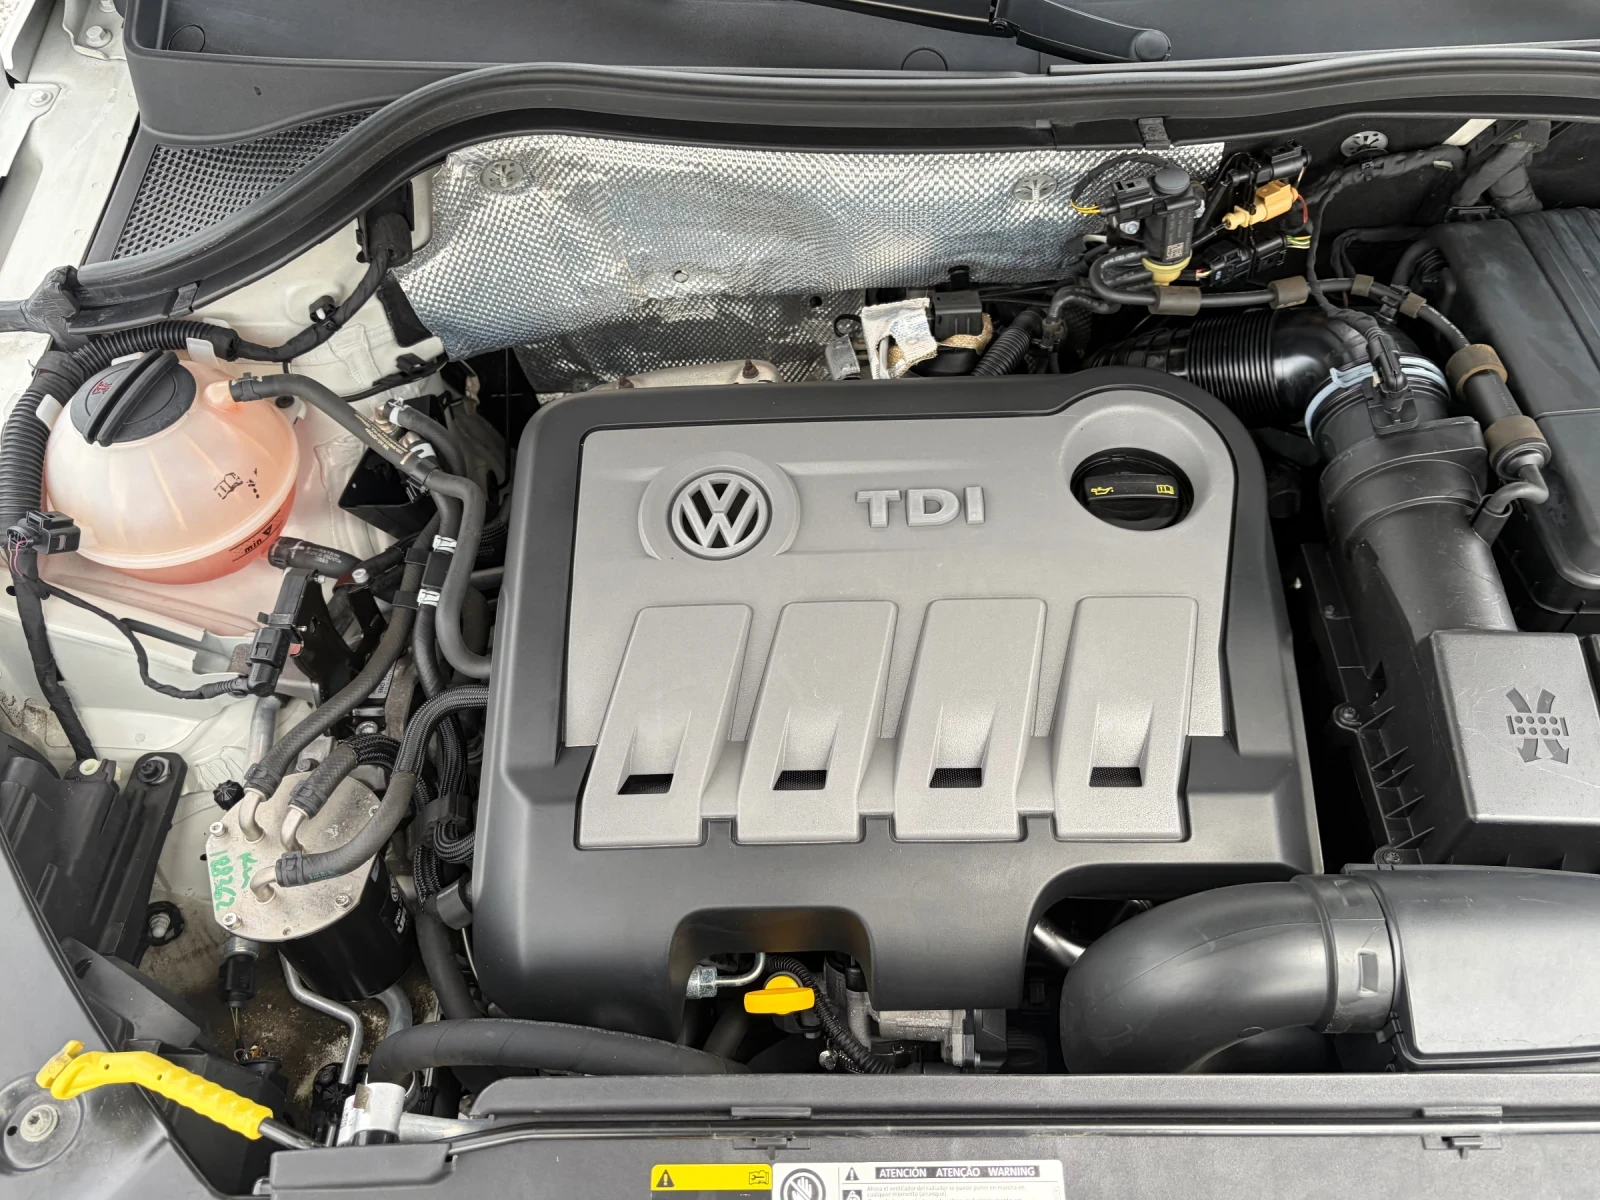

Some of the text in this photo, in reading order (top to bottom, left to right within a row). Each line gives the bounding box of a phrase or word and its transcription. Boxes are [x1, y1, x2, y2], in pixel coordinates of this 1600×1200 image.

[855, 485, 986, 529] TDI
[244, 538, 262, 554] min
[879, 1165, 1035, 1178] ATENCIÓN ATENÇÃO WARNING
